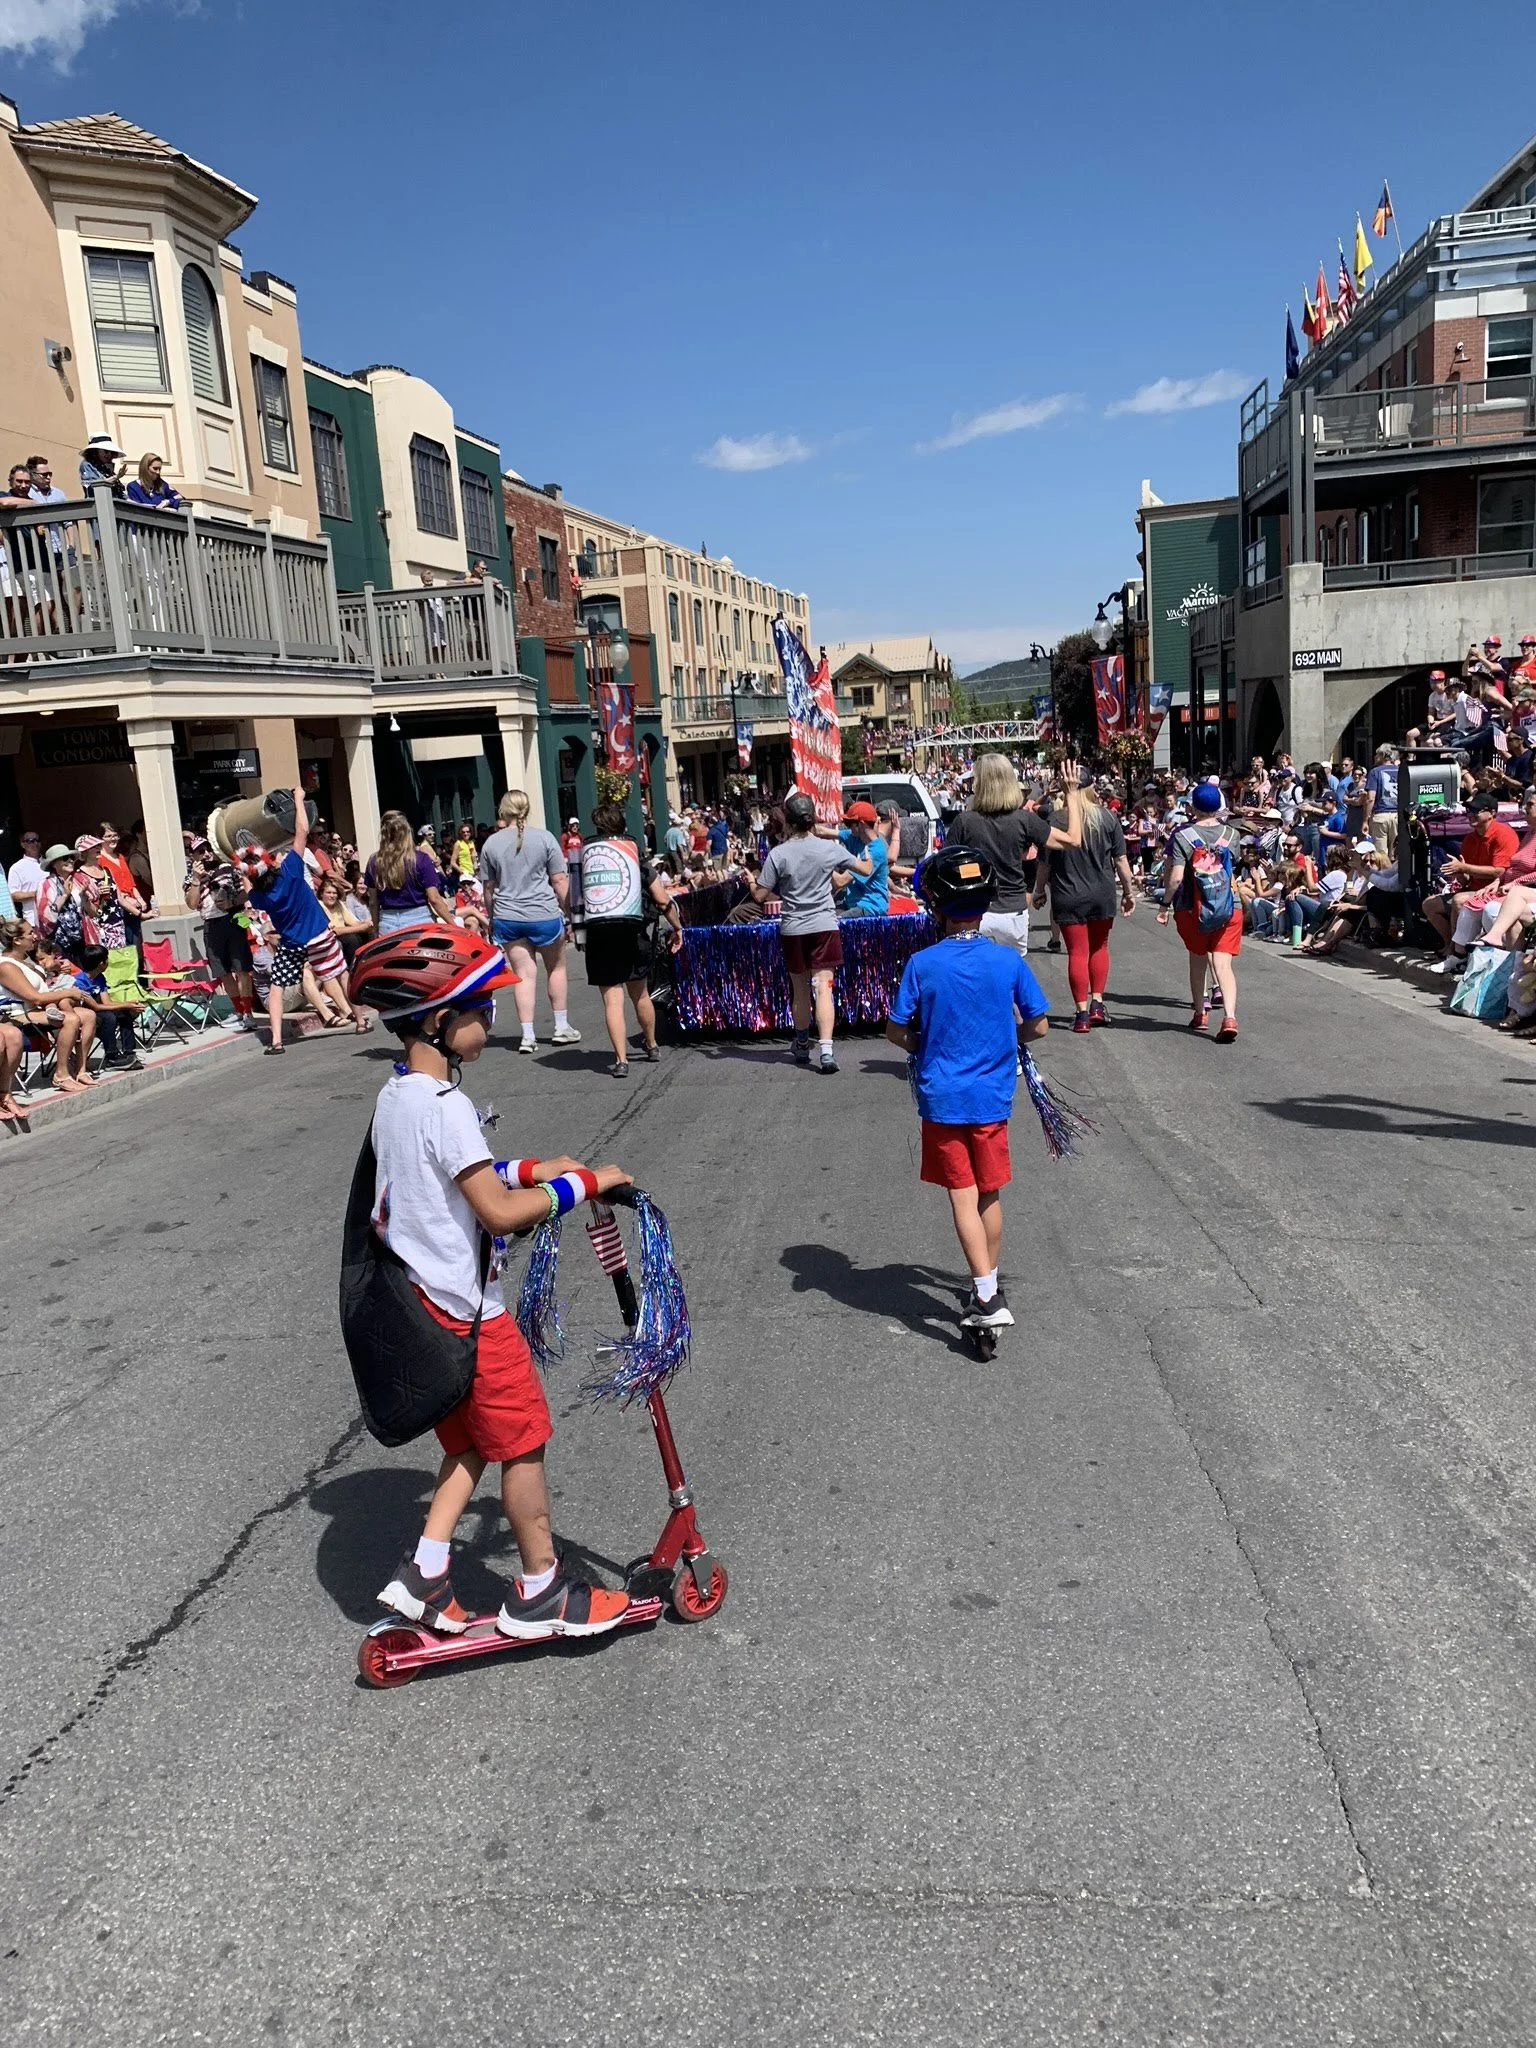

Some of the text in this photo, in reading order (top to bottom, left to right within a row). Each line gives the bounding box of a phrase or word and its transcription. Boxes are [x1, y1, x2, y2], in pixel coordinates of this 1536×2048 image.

[1295, 650, 1340, 666] 692 MAIN
[63, 729, 110, 745] TOWN
[213, 758, 246, 768] PARK CITY
[1420, 786, 1442, 794] PHONE
[423, 951, 455, 960] GIRO
